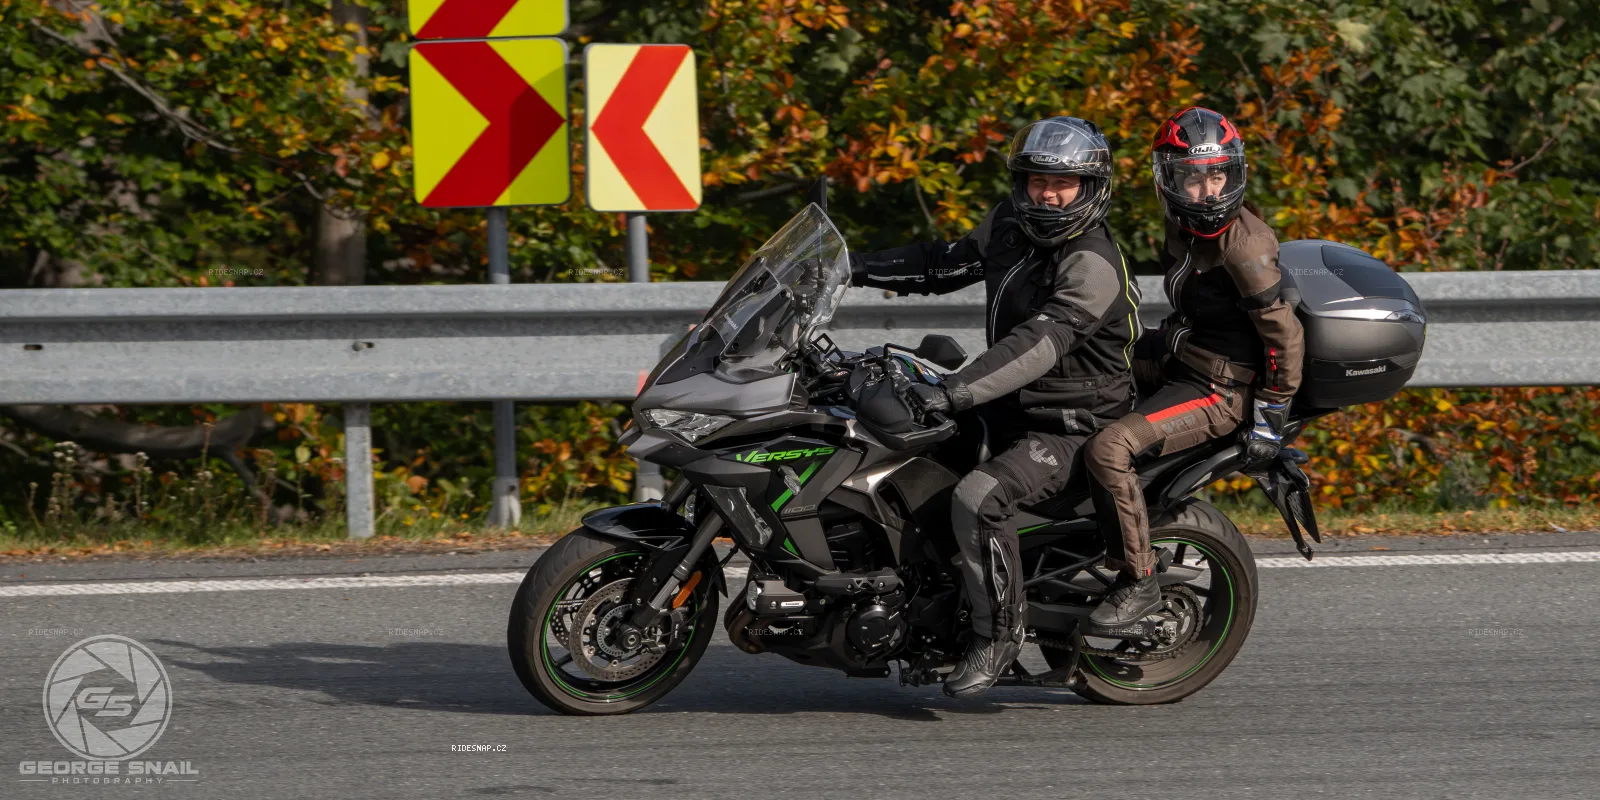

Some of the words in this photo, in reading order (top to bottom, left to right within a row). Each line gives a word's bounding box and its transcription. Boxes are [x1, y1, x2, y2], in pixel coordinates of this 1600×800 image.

[1033, 155, 1057, 163] HJC
[1345, 365, 1387, 377] Kawasaki
[735, 446, 835, 463] VERSYS
[784, 504, 816, 514] 1100
